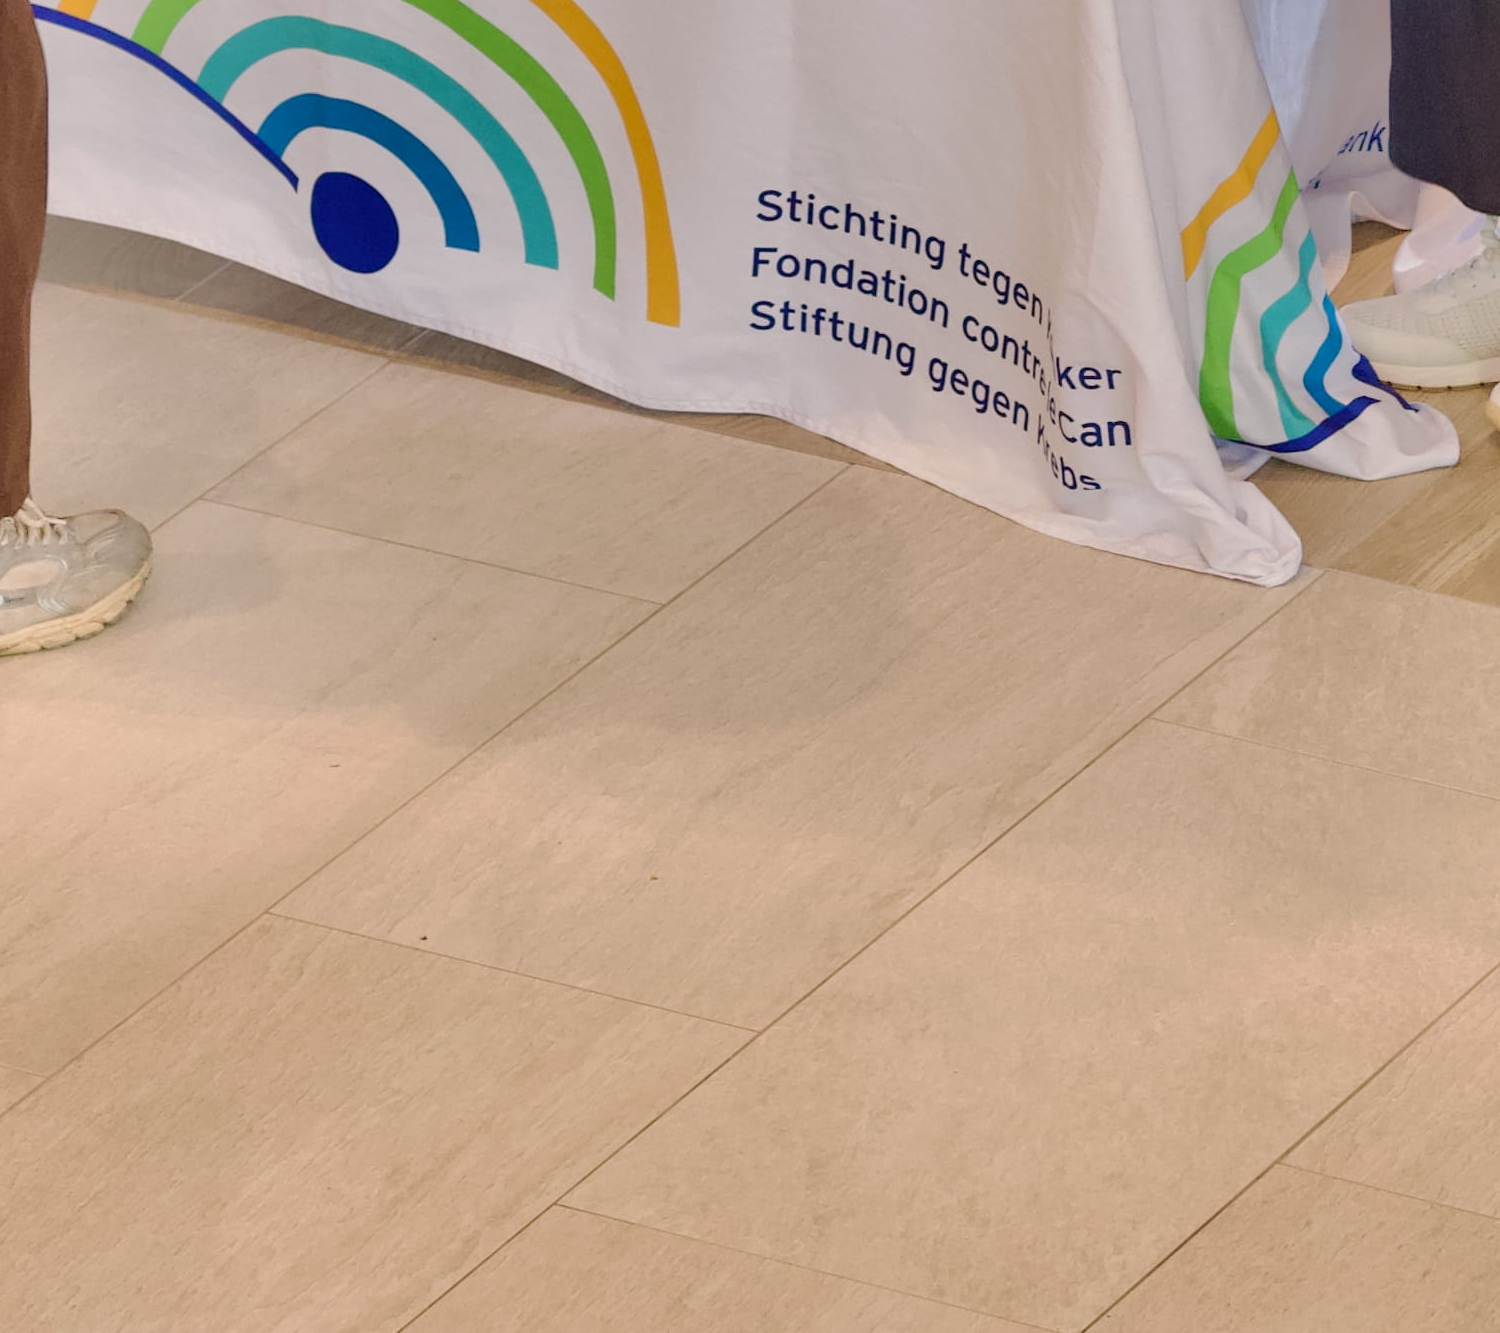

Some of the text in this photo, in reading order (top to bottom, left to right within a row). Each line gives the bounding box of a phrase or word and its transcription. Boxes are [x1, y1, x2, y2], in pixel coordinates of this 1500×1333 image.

[750, 245, 950, 329] Fondation
[961, 311, 1047, 397] contre
[755, 188, 946, 271] Stichting
[957, 240, 1045, 328] tegen
[749, 300, 917, 377] Stiftung
[927, 357, 1030, 433] gegen
